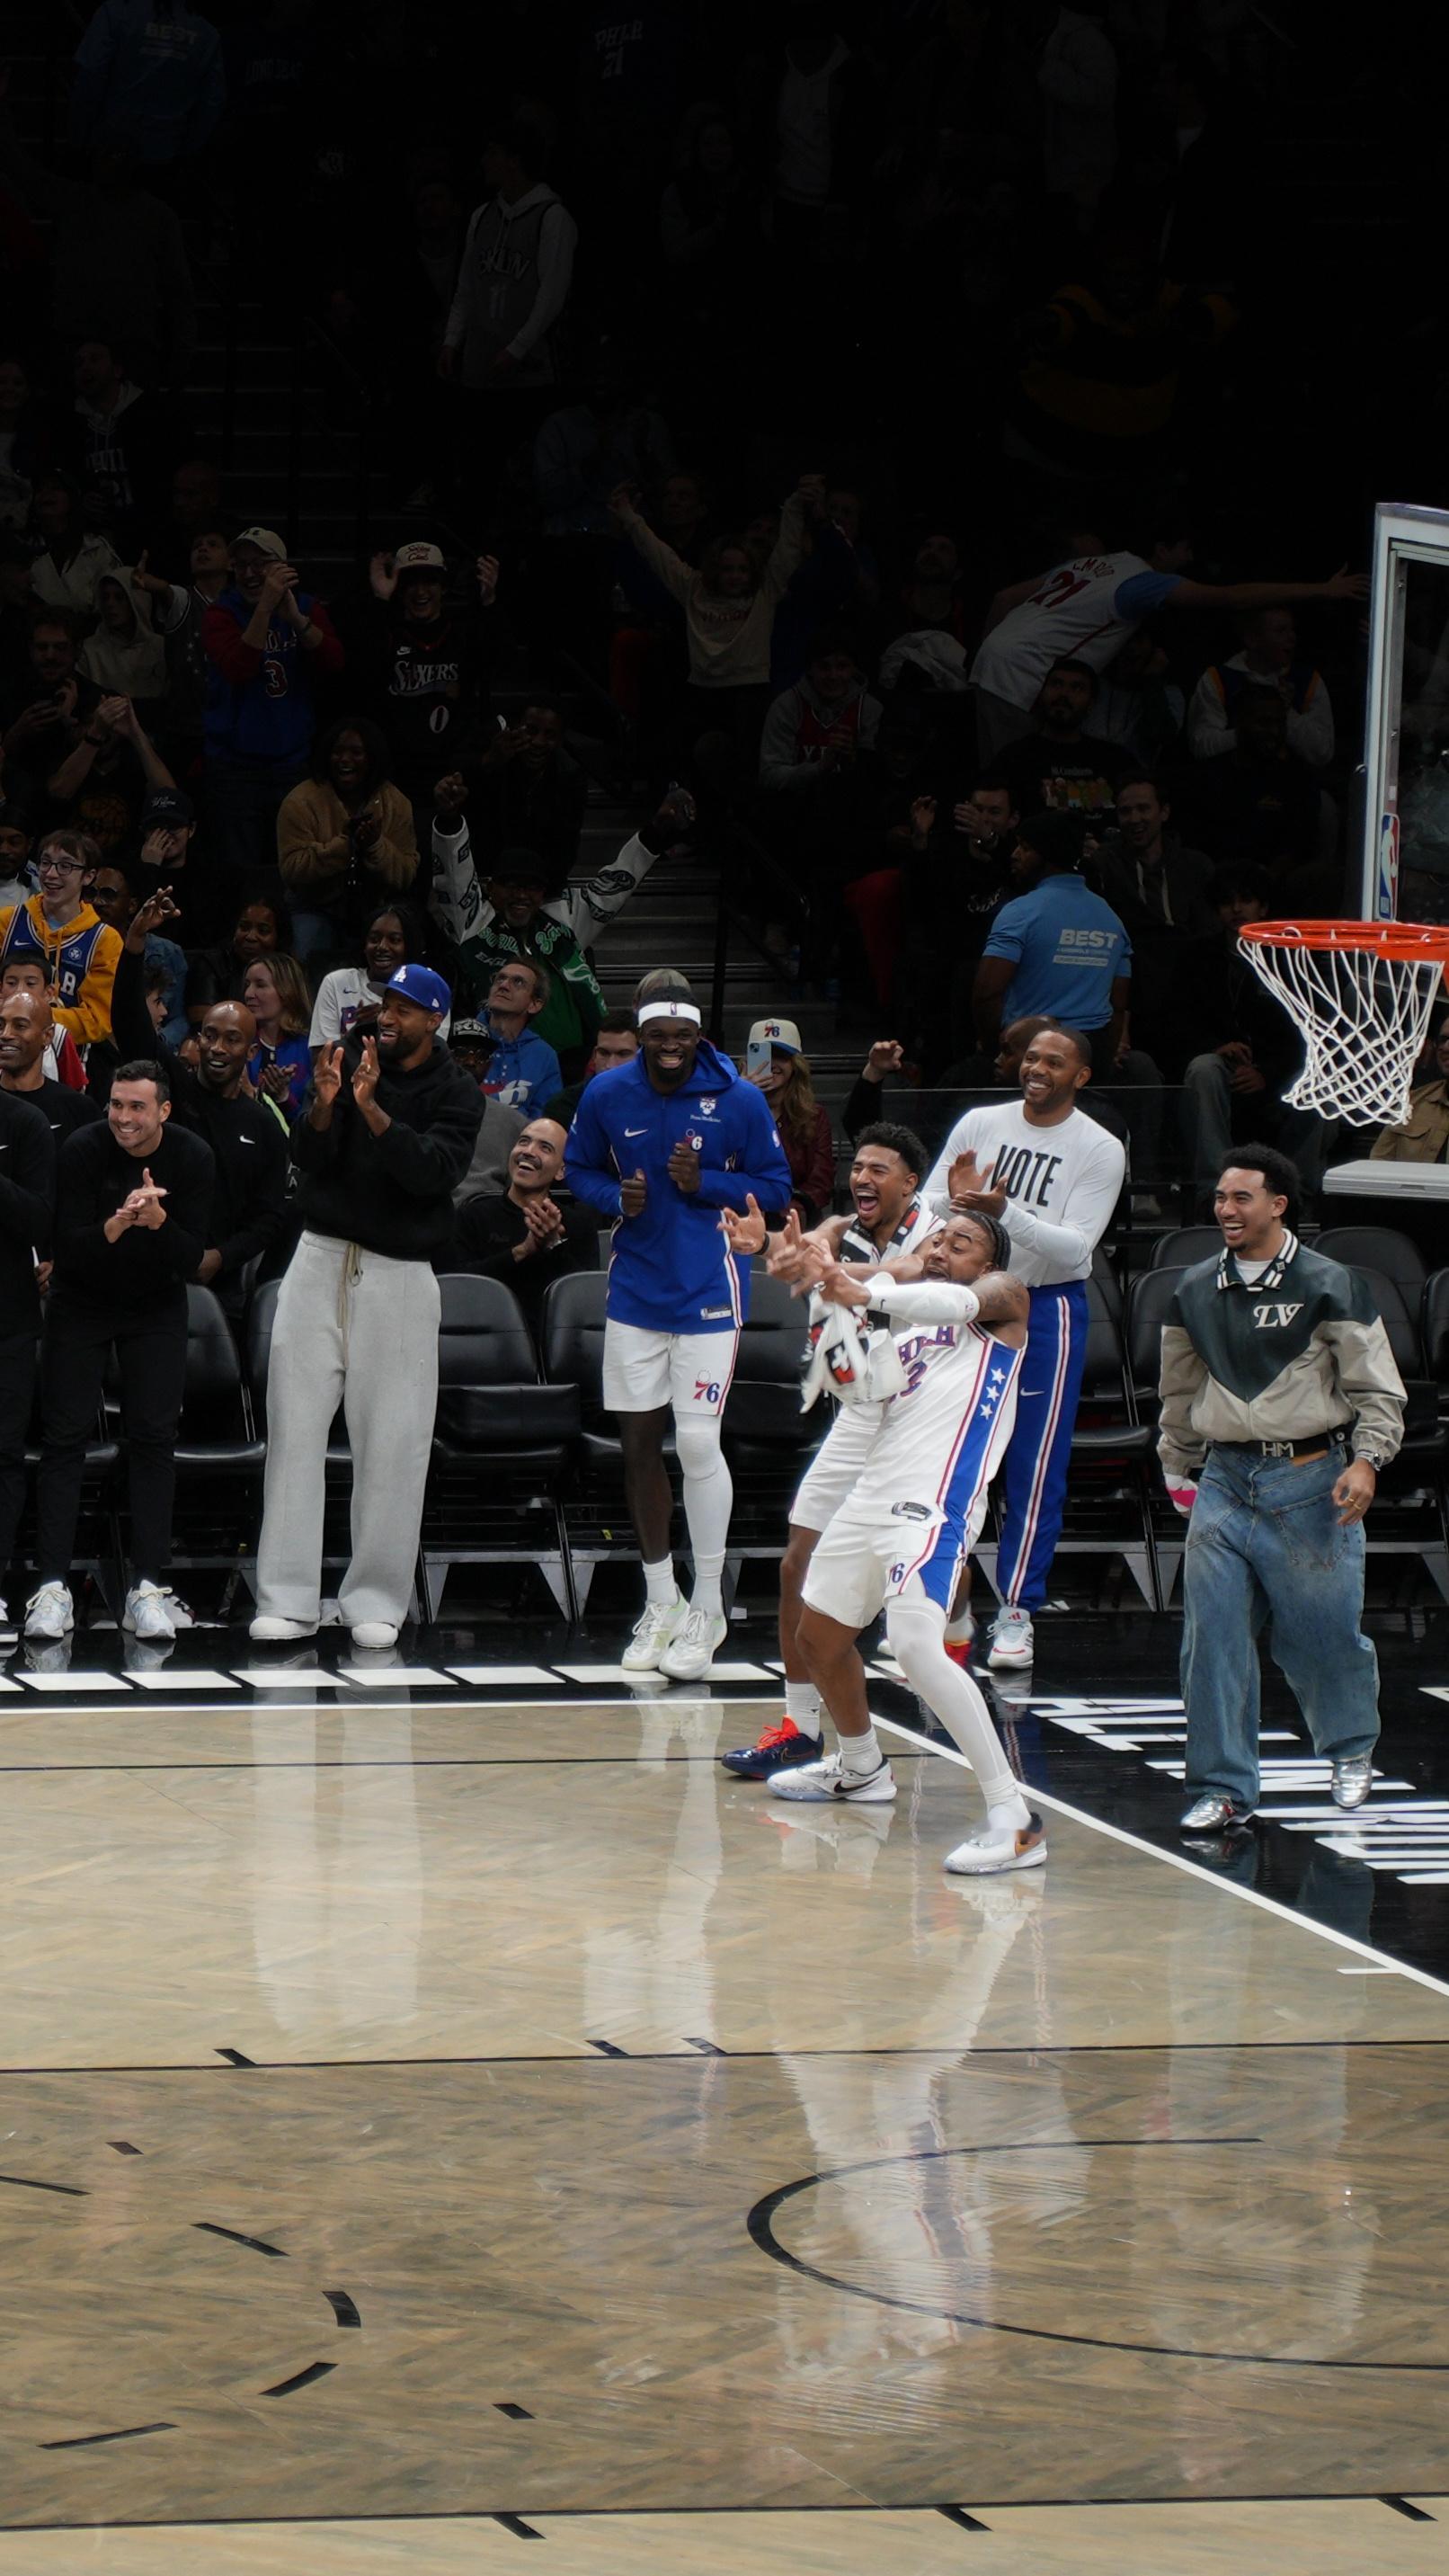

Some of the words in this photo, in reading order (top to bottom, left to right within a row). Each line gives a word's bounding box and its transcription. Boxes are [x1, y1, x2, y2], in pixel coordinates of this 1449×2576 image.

[1027, 570, 1091, 609] 21
[265, 660, 288, 697] 3
[429, 705, 449, 734] 0
[1059, 929, 1118, 949] BEST
[764, 1026, 780, 1037] 76
[991, 1145, 1062, 1207] VOTE
[1253, 1304, 1304, 1328] LV
[693, 1380, 720, 1403] 76
